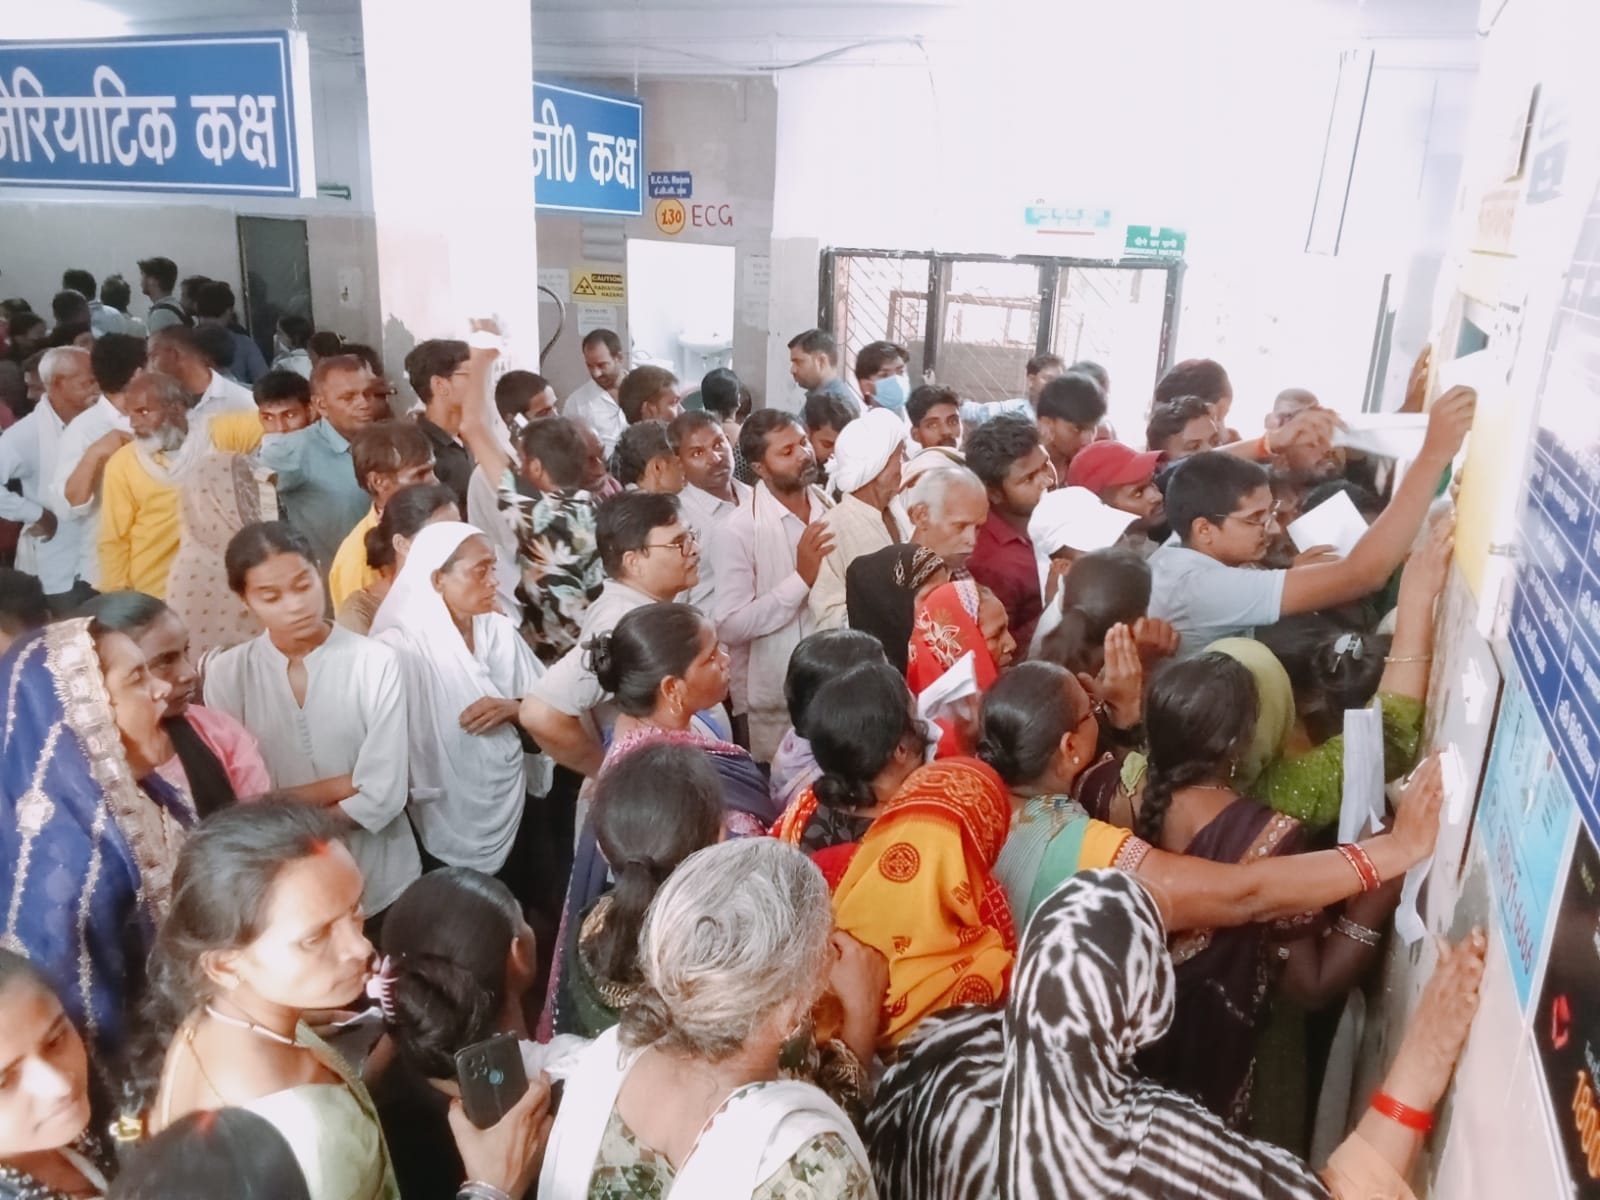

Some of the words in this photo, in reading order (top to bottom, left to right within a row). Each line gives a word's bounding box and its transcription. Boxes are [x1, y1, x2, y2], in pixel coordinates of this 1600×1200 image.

[190, 95, 277, 169] कक्ष
[587, 131, 637, 190] कक्ष
[661, 208, 682, 226] 130
[691, 204, 734, 227] ECG
